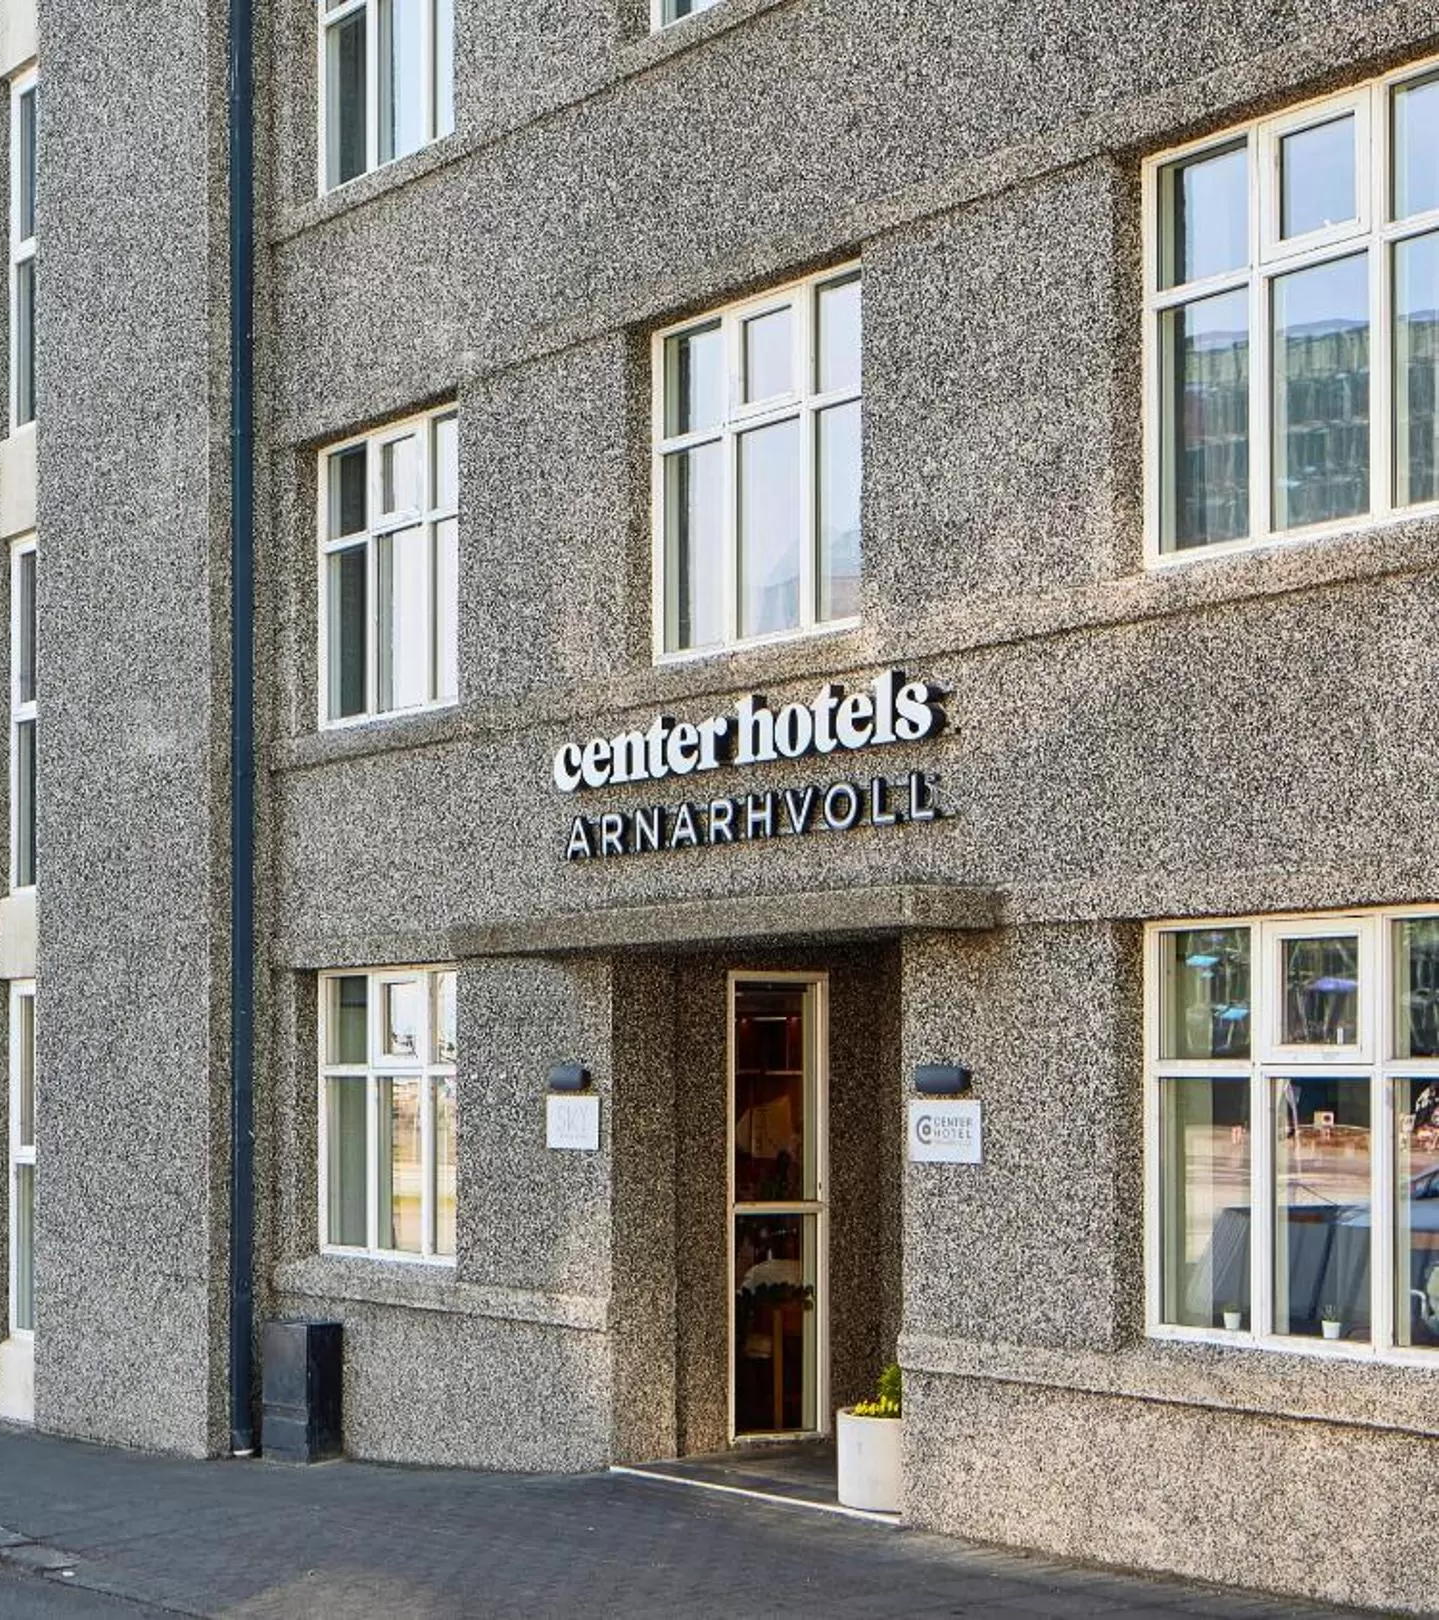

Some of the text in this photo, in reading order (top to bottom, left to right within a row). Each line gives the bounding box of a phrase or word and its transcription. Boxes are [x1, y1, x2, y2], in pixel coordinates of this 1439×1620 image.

[554, 670, 933, 792] center hotels
[566, 772, 935, 859] ARNARHVOLL
